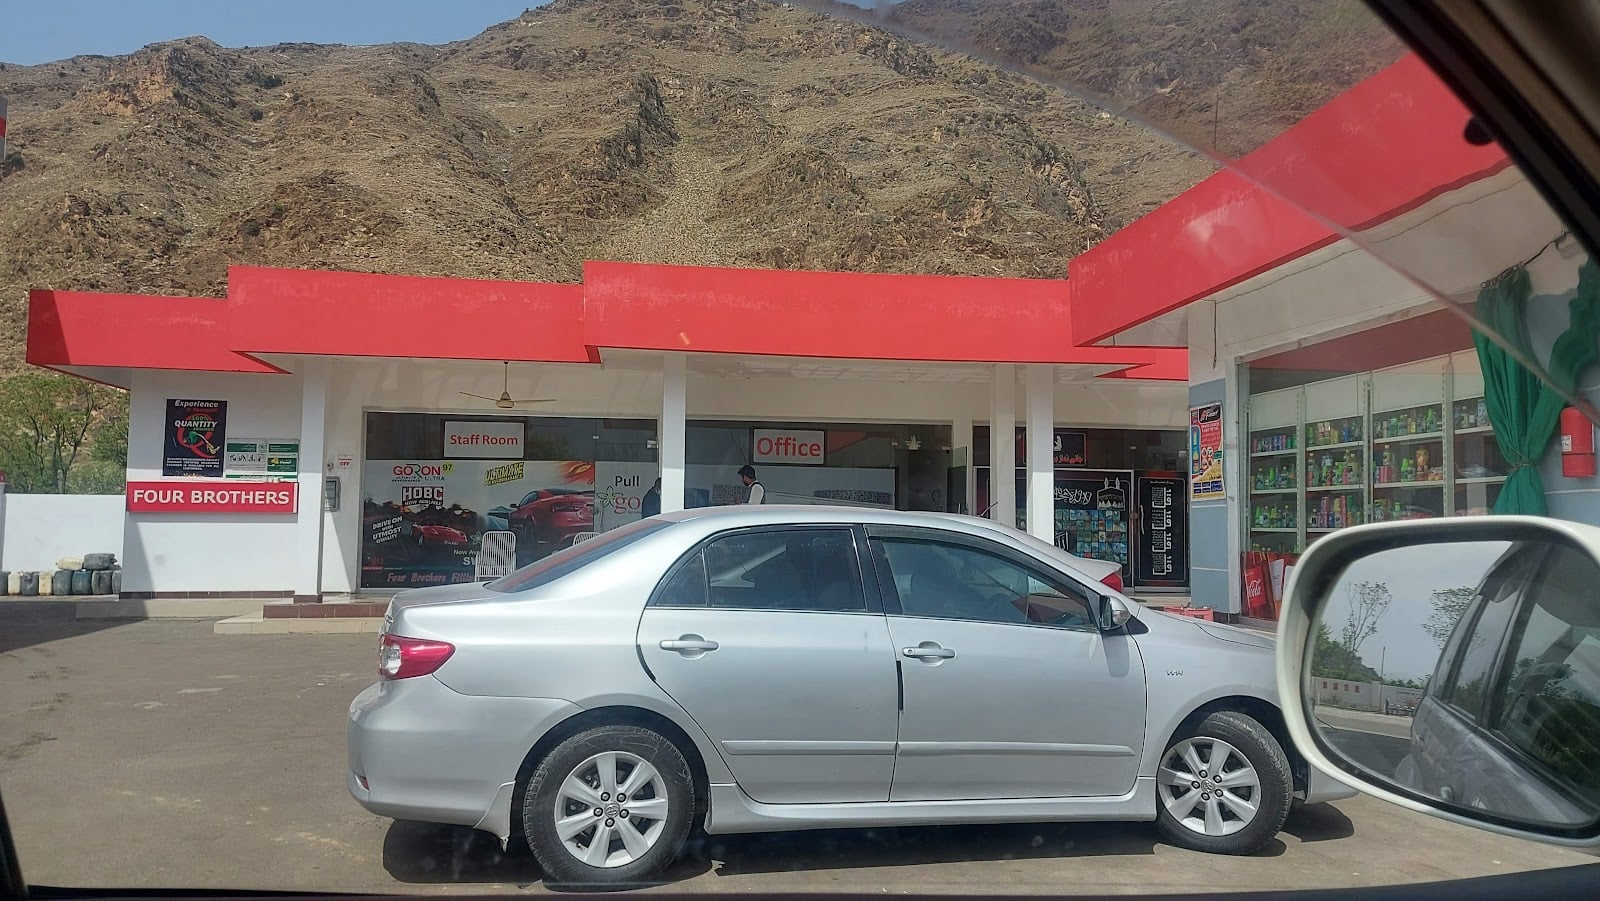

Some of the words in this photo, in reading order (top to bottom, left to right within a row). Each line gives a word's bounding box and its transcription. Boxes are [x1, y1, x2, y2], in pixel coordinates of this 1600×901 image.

[174, 399, 219, 408] Experience
[174, 420, 218, 428] QUANTITY
[450, 434, 480, 446] Staff
[482, 435, 518, 446] Room
[756, 436, 821, 457] Office
[615, 475, 640, 487] Pull
[133, 489, 185, 504] FOUR
[190, 490, 290, 505] BROTHERS
[402, 487, 443, 502] HOBC
[613, 496, 641, 515] go
[372, 519, 392, 530] DRIVE
[391, 515, 403, 524] ON
[372, 526, 402, 540] UTMOST
